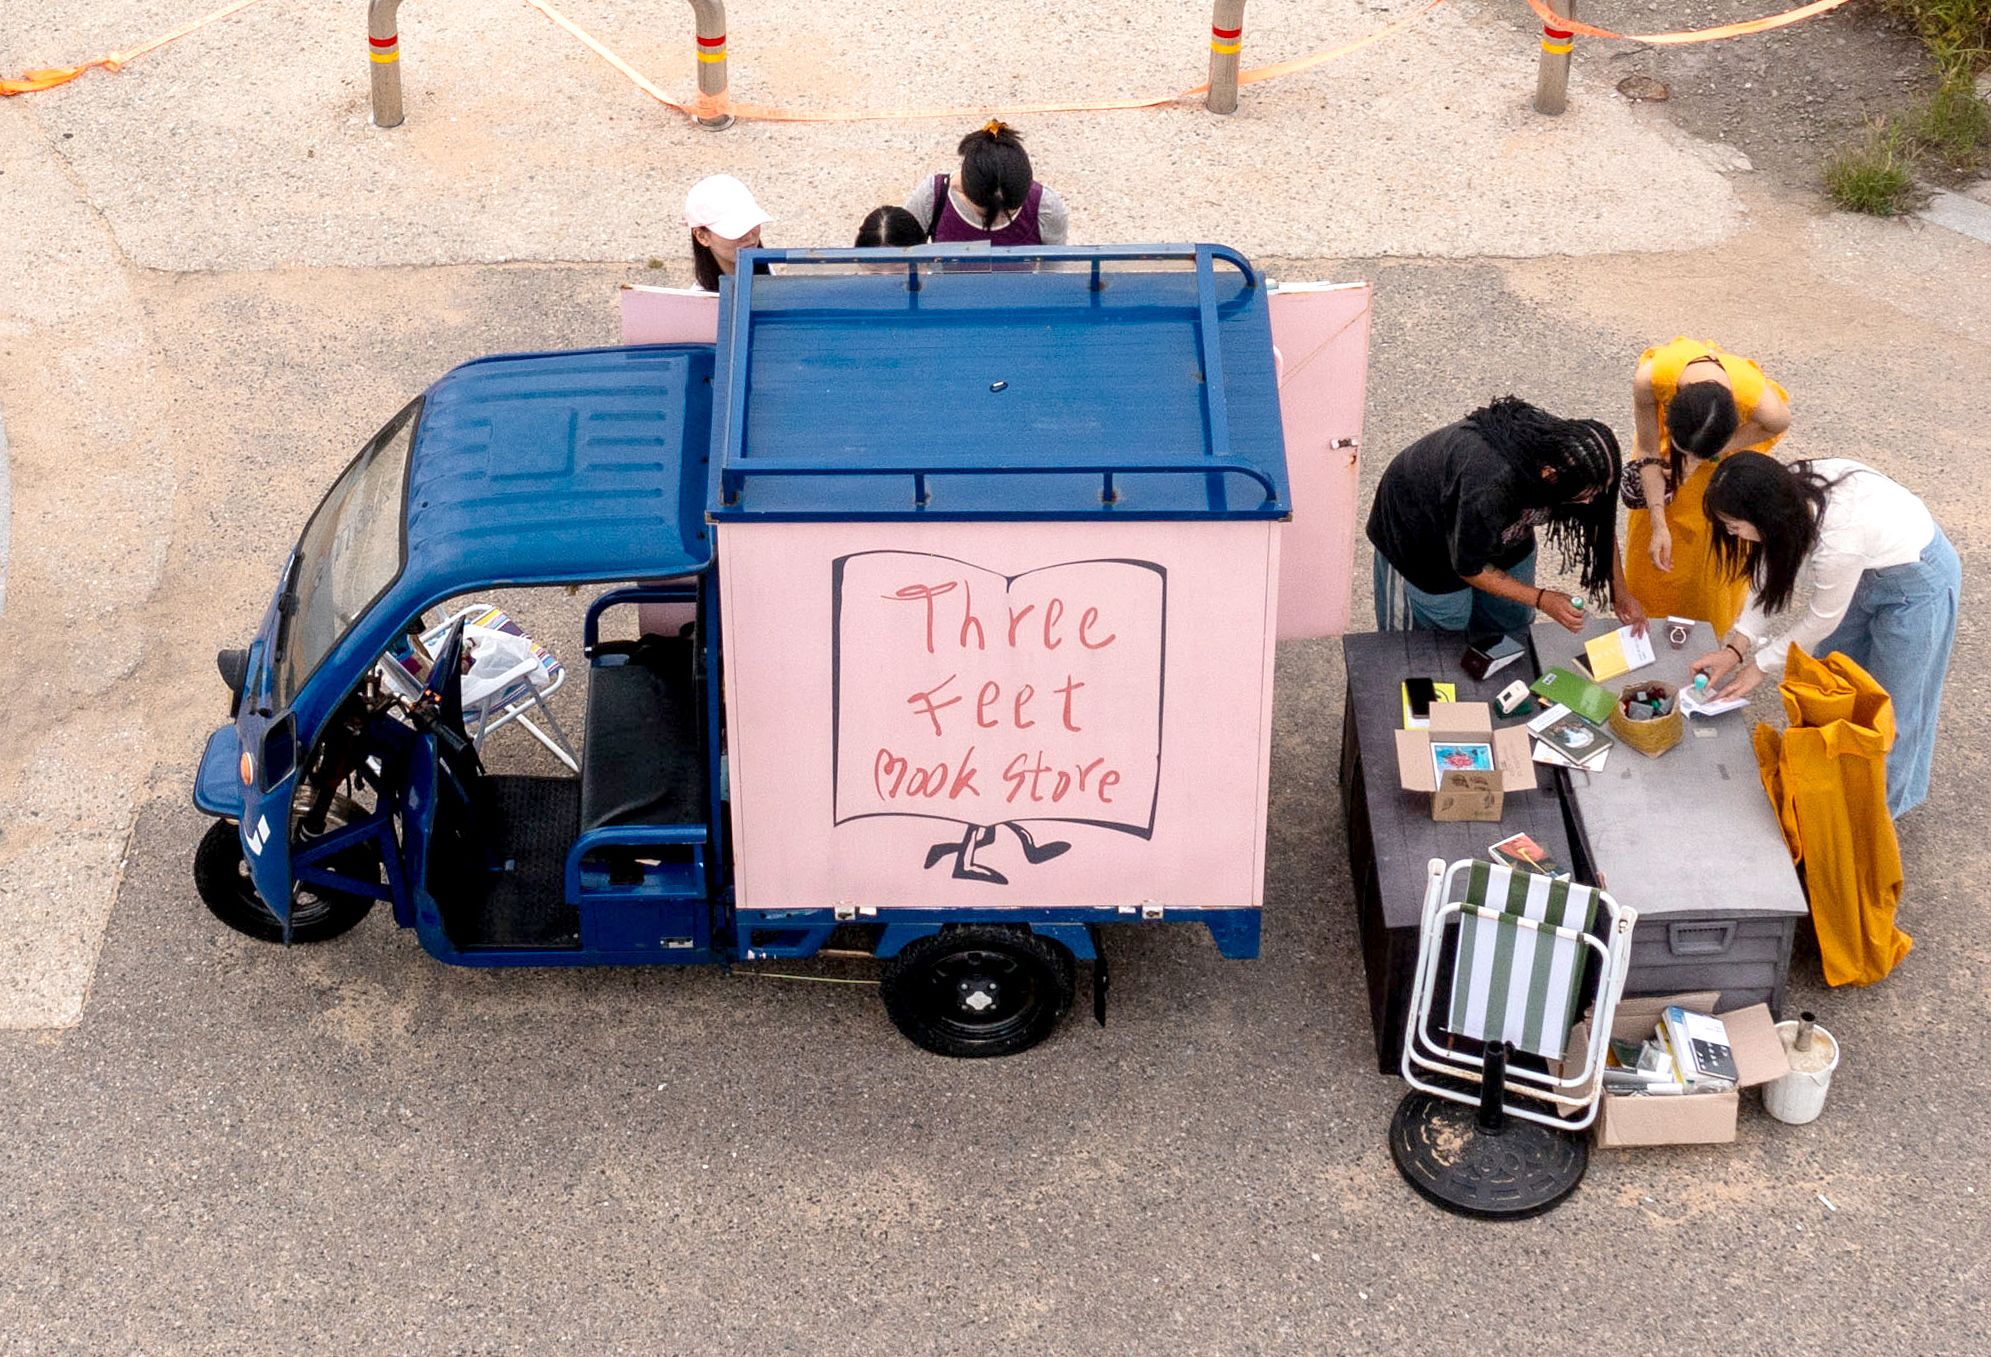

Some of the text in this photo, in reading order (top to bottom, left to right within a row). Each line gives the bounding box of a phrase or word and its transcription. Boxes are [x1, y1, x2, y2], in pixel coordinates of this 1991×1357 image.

[881, 580, 1116, 653] Three
[907, 674, 1085, 736] Feet
[1002, 751, 1121, 803] Store
